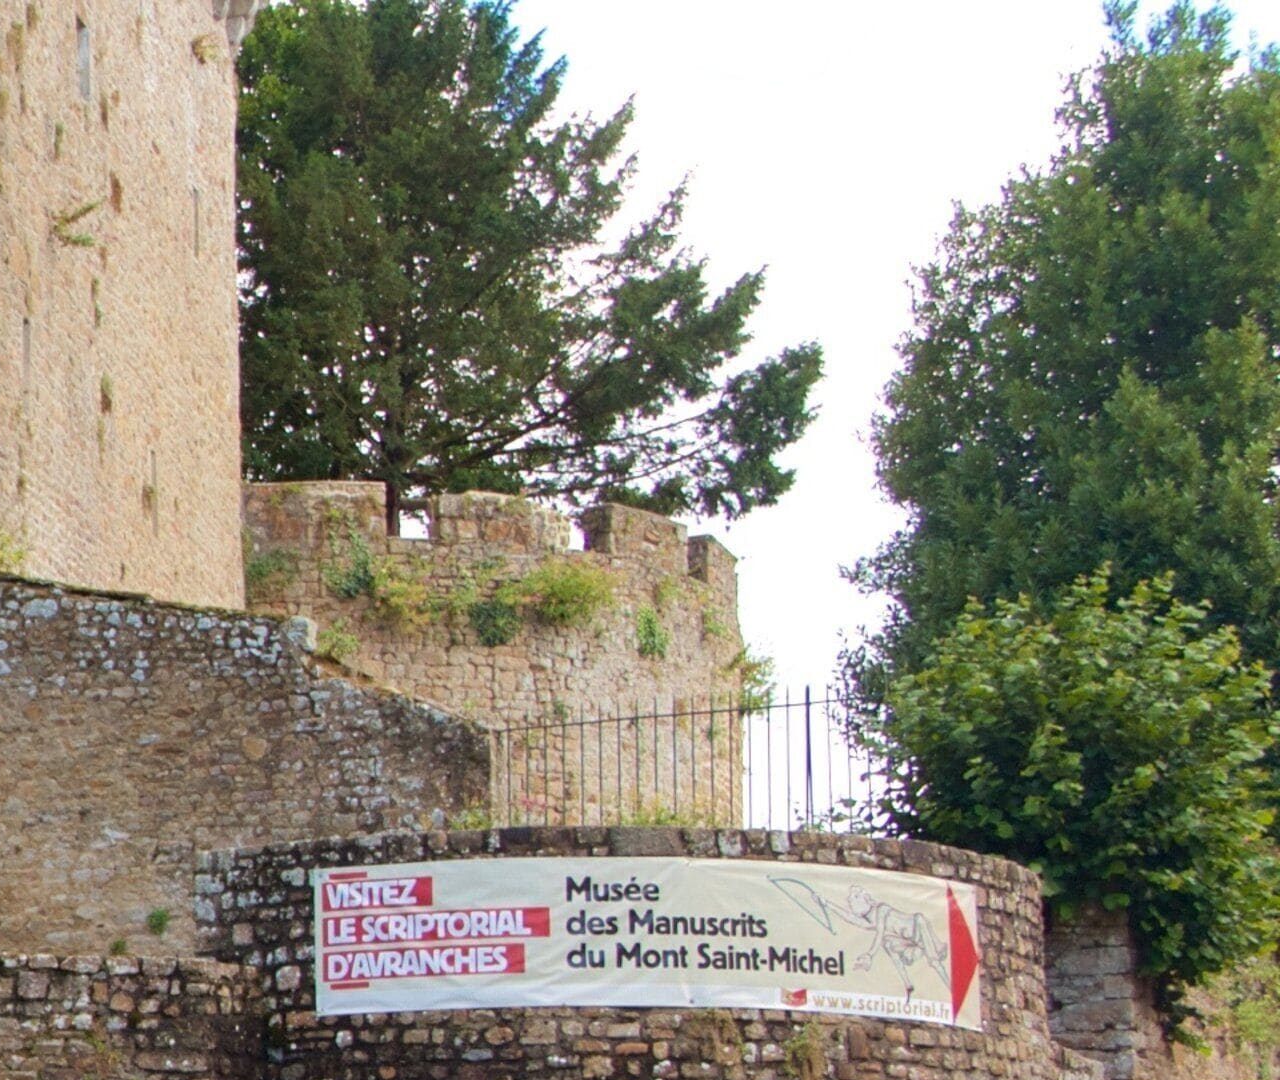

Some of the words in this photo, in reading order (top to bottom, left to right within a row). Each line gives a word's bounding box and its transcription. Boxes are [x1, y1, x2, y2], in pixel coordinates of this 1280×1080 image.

[326, 879, 417, 909] VISITEZ
[566, 876, 660, 902] Musée
[327, 918, 357, 945] LE
[361, 910, 532, 942] SCRIPTORIAL
[566, 909, 618, 935] des
[629, 909, 768, 938] Manuscrits
[327, 946, 508, 980] D'AVRANCHES
[566, 942, 605, 969] du
[616, 942, 688, 969] Mont
[697, 943, 845, 976] Saint-Michel
[812, 994, 950, 1019] www.scriptorial.fr
